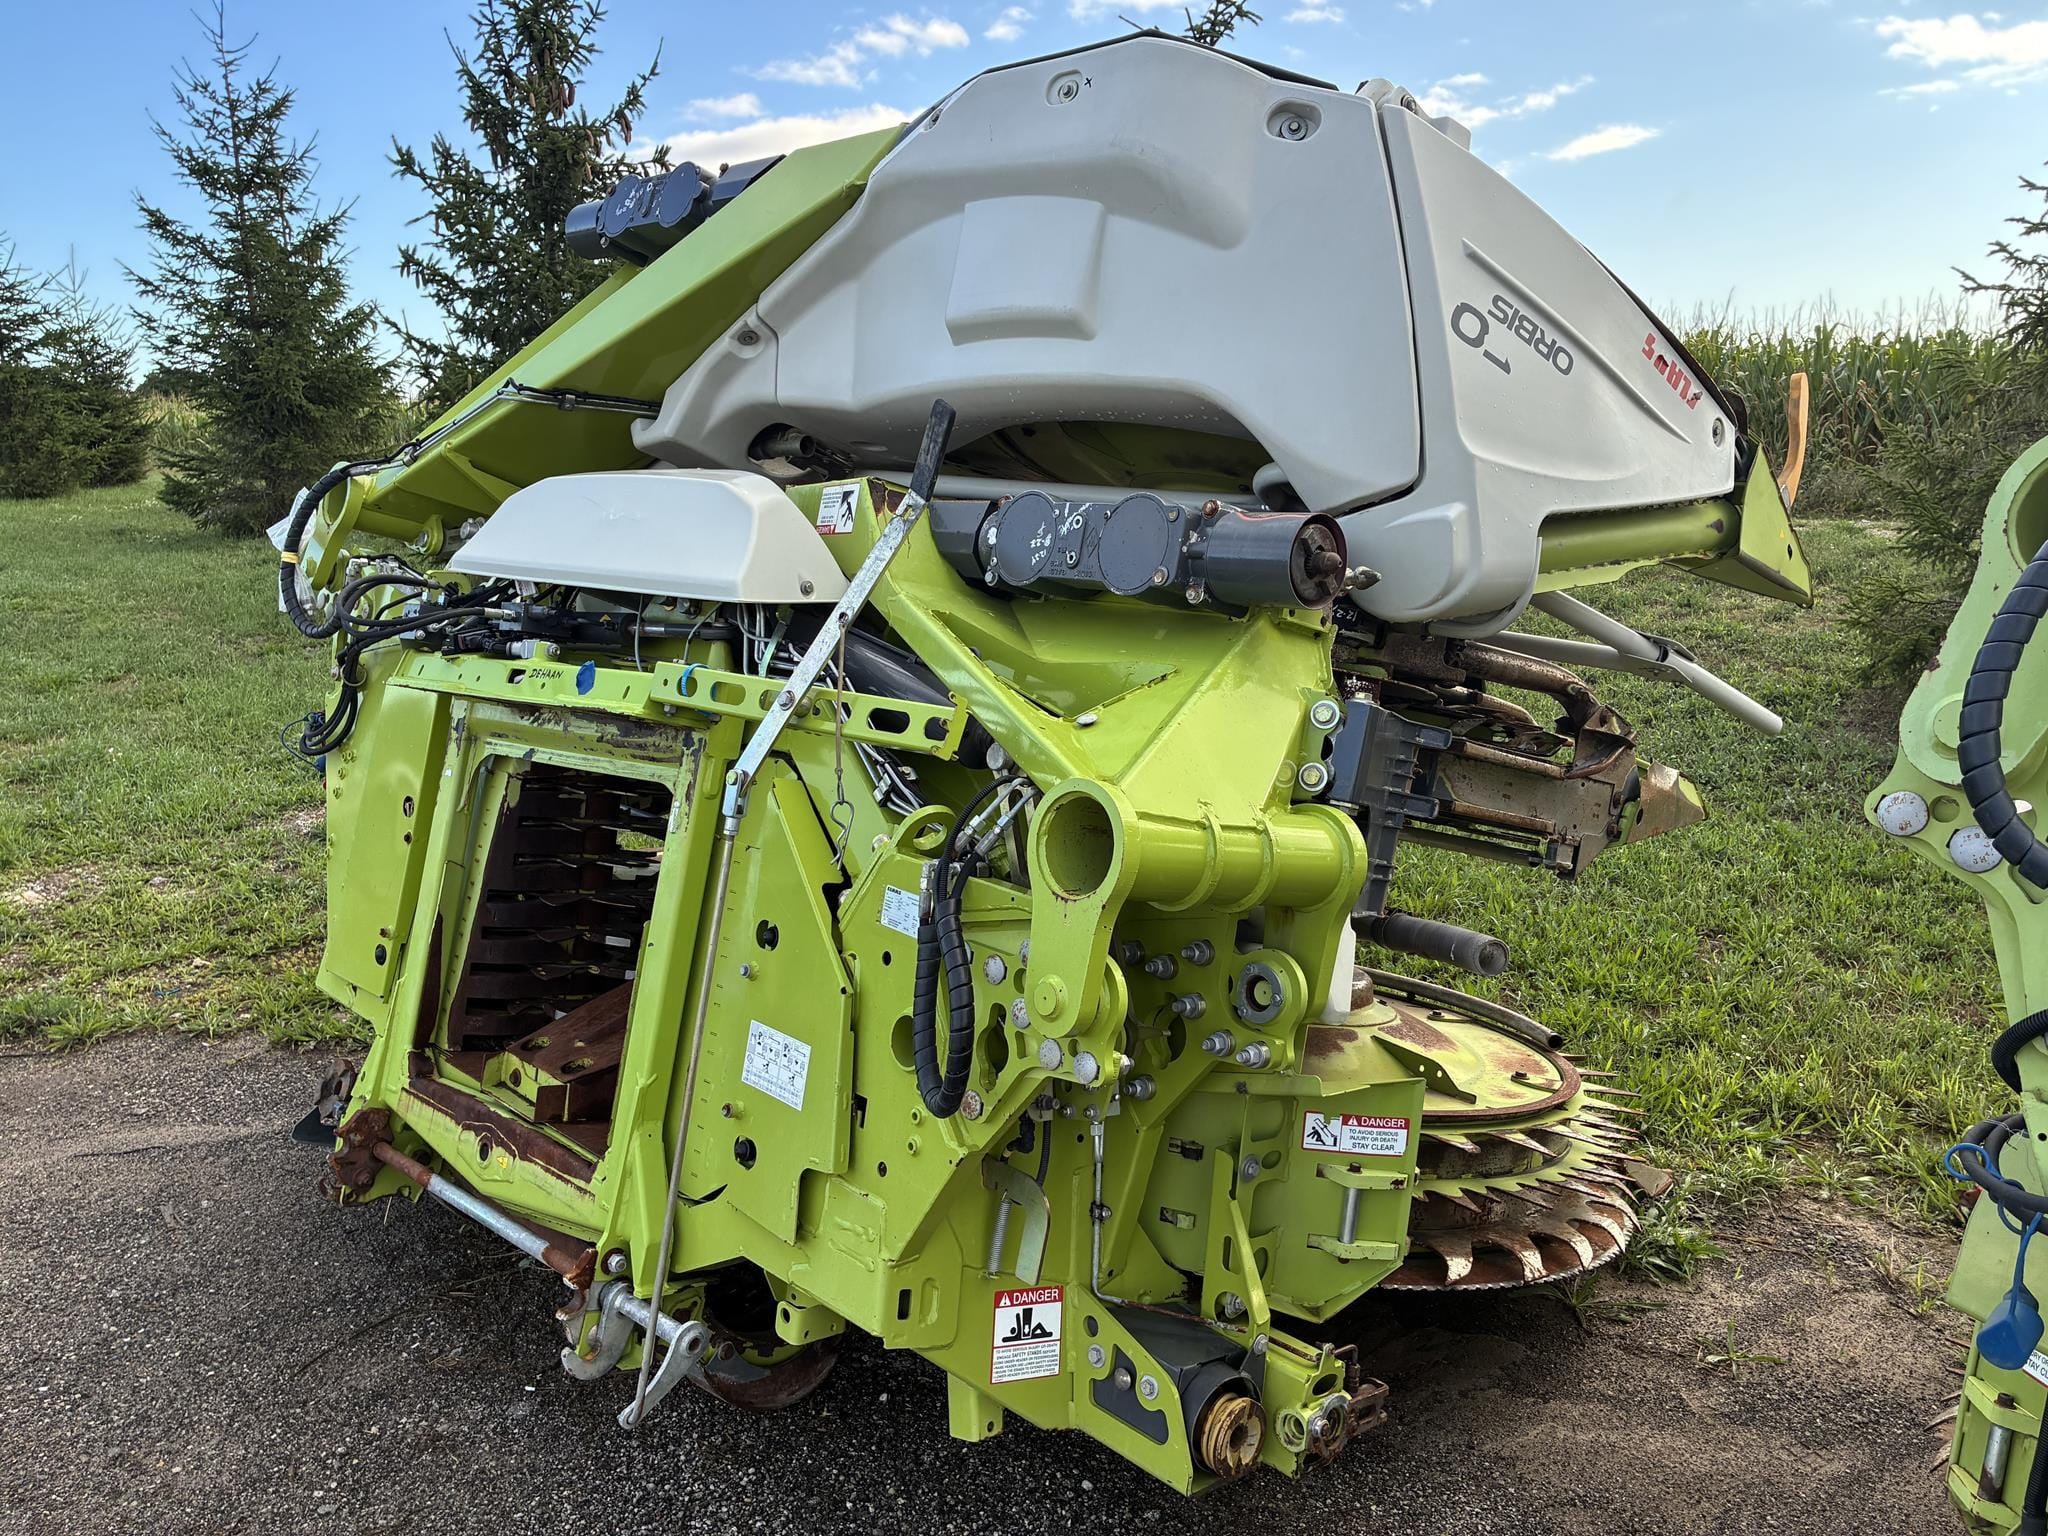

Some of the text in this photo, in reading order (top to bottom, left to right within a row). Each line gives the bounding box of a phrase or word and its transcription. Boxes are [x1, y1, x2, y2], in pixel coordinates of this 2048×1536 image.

[1450, 302, 1512, 376] 10
[1487, 294, 1574, 376] ORBIS
[529, 668, 565, 680] DEHAAN
[1361, 1118, 1405, 1128] DANGER
[1371, 1143, 1395, 1151] CLEAR
[1013, 1289, 1059, 1304] DANGER
[2028, 1358, 2040, 1371] TAY
